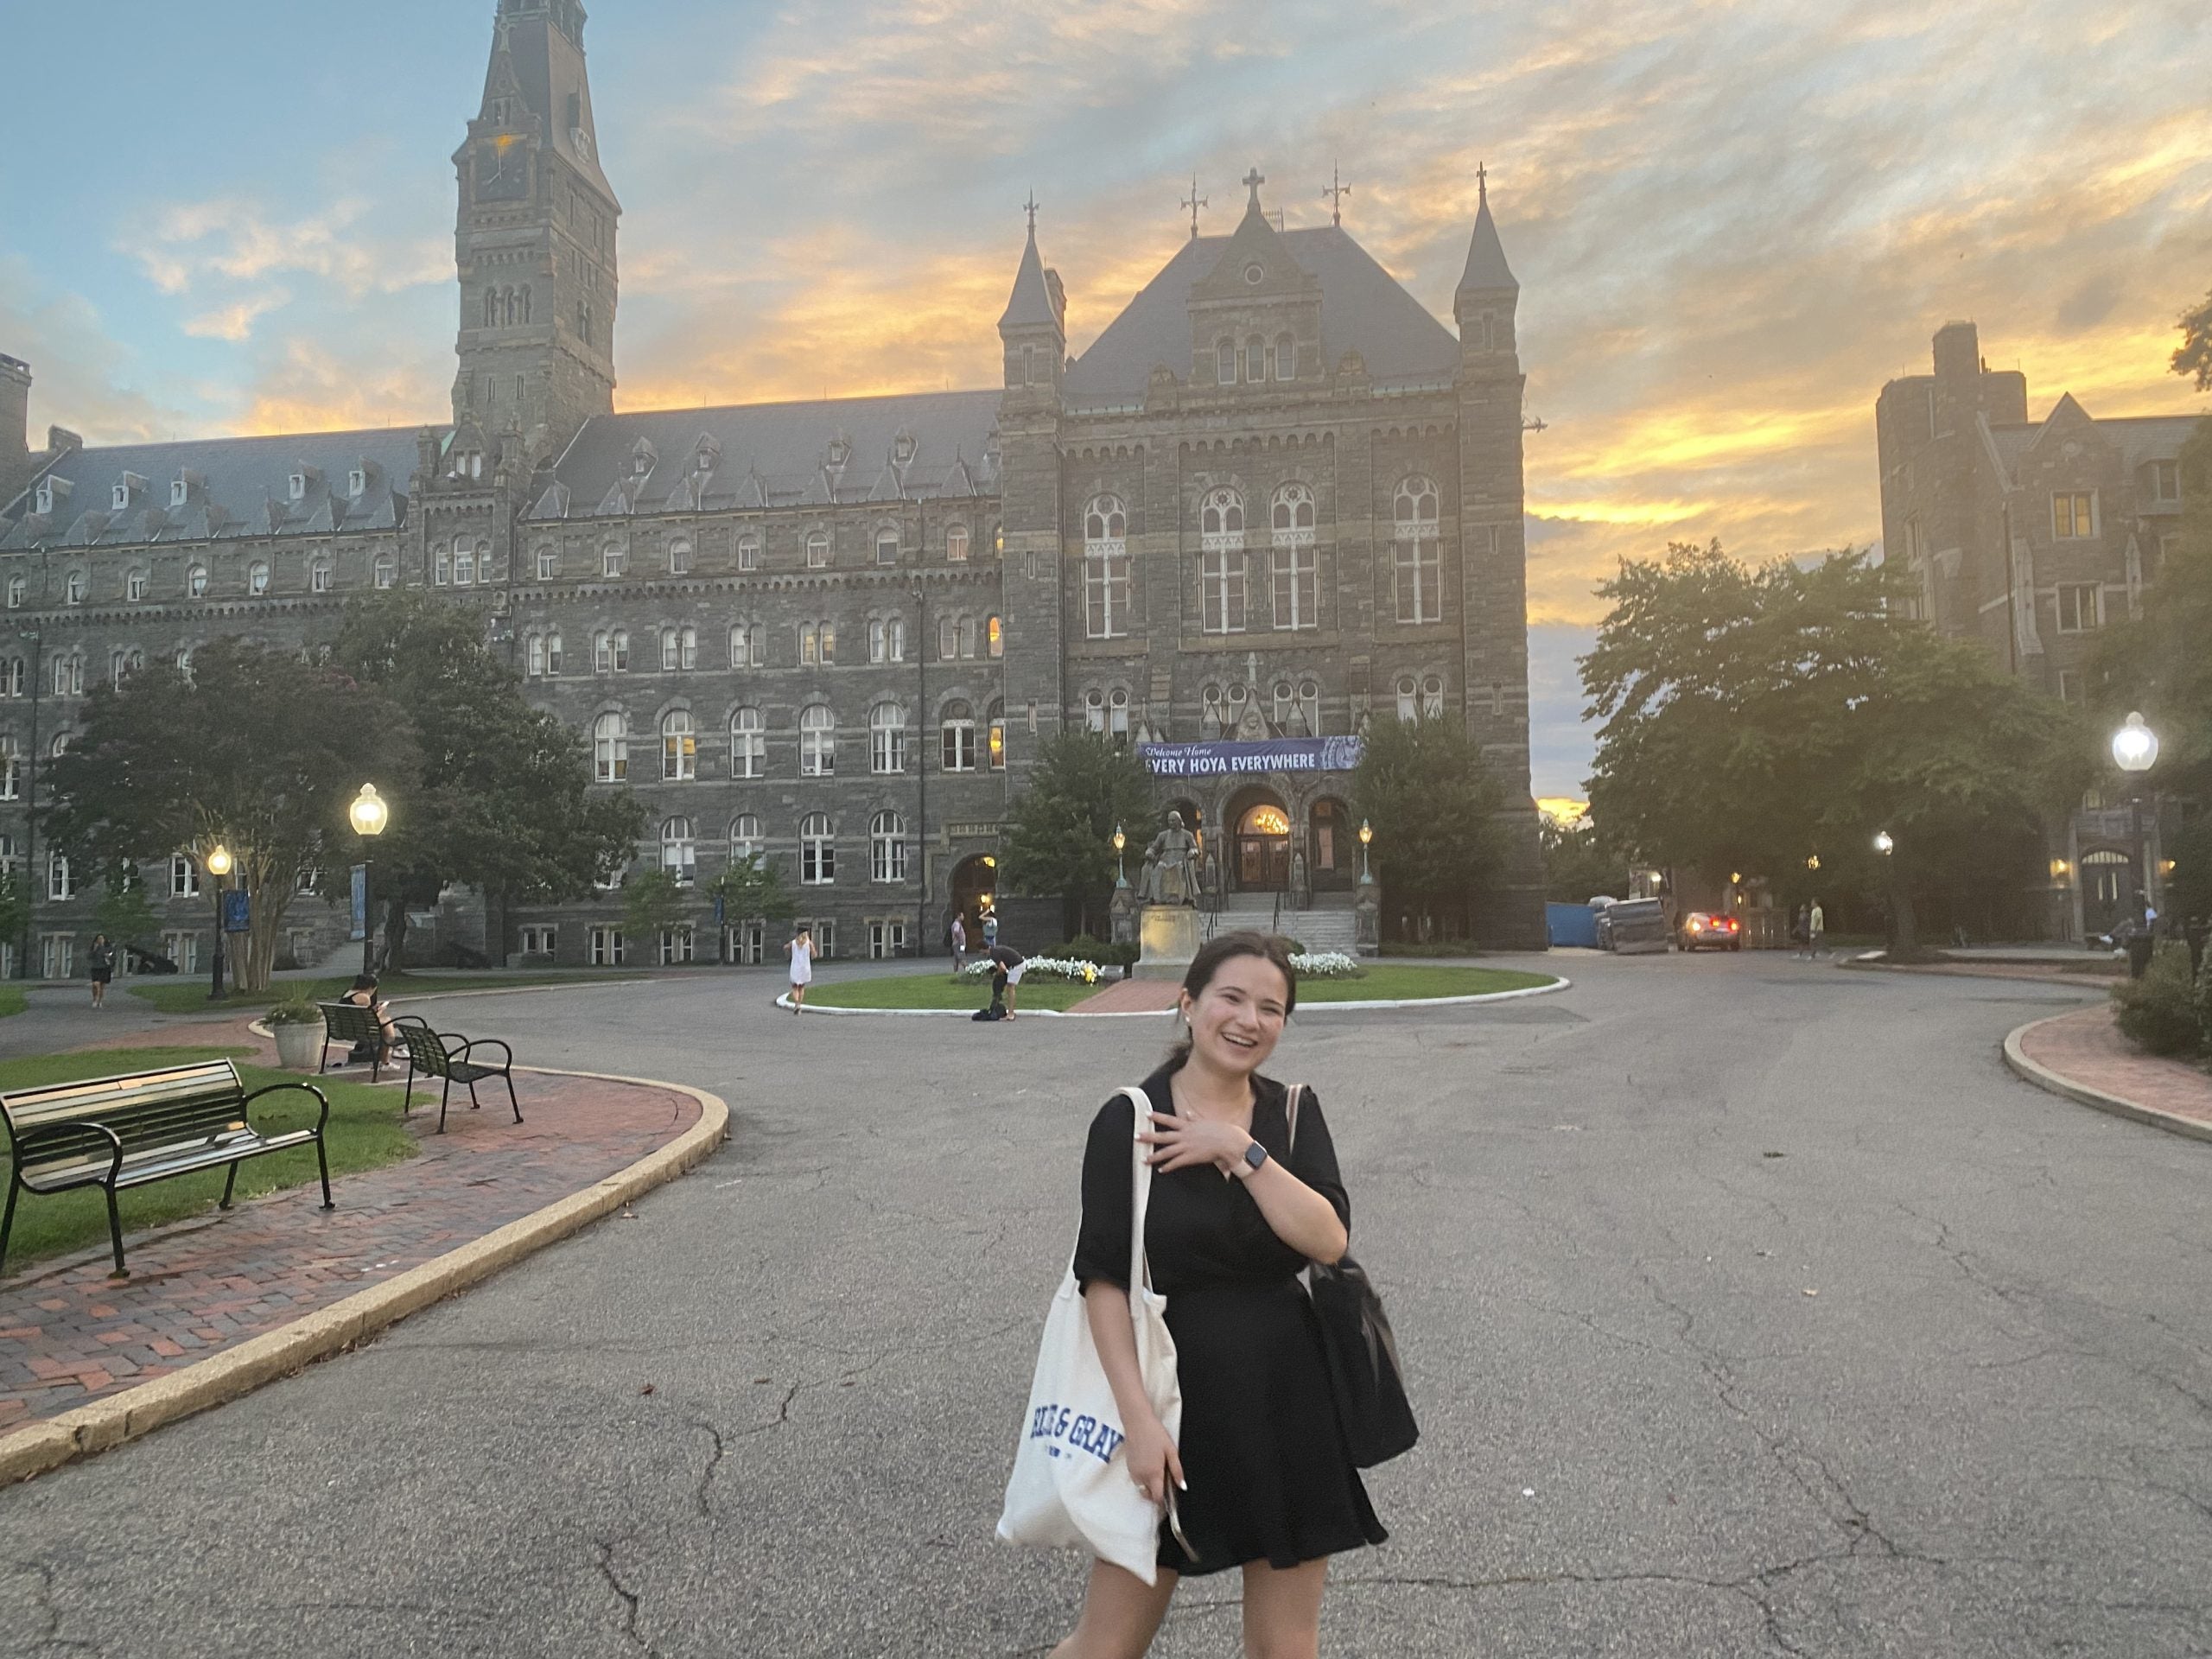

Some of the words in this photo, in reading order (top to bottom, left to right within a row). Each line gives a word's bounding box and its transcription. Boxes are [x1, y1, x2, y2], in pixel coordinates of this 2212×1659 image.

[1145, 747, 1183, 757] Welcome
[1184, 745, 1211, 756] Home
[1190, 757, 1227, 772] HOYA
[1231, 753, 1315, 772] EVERYWHERE
[1069, 1414, 1125, 1464] GRAY
